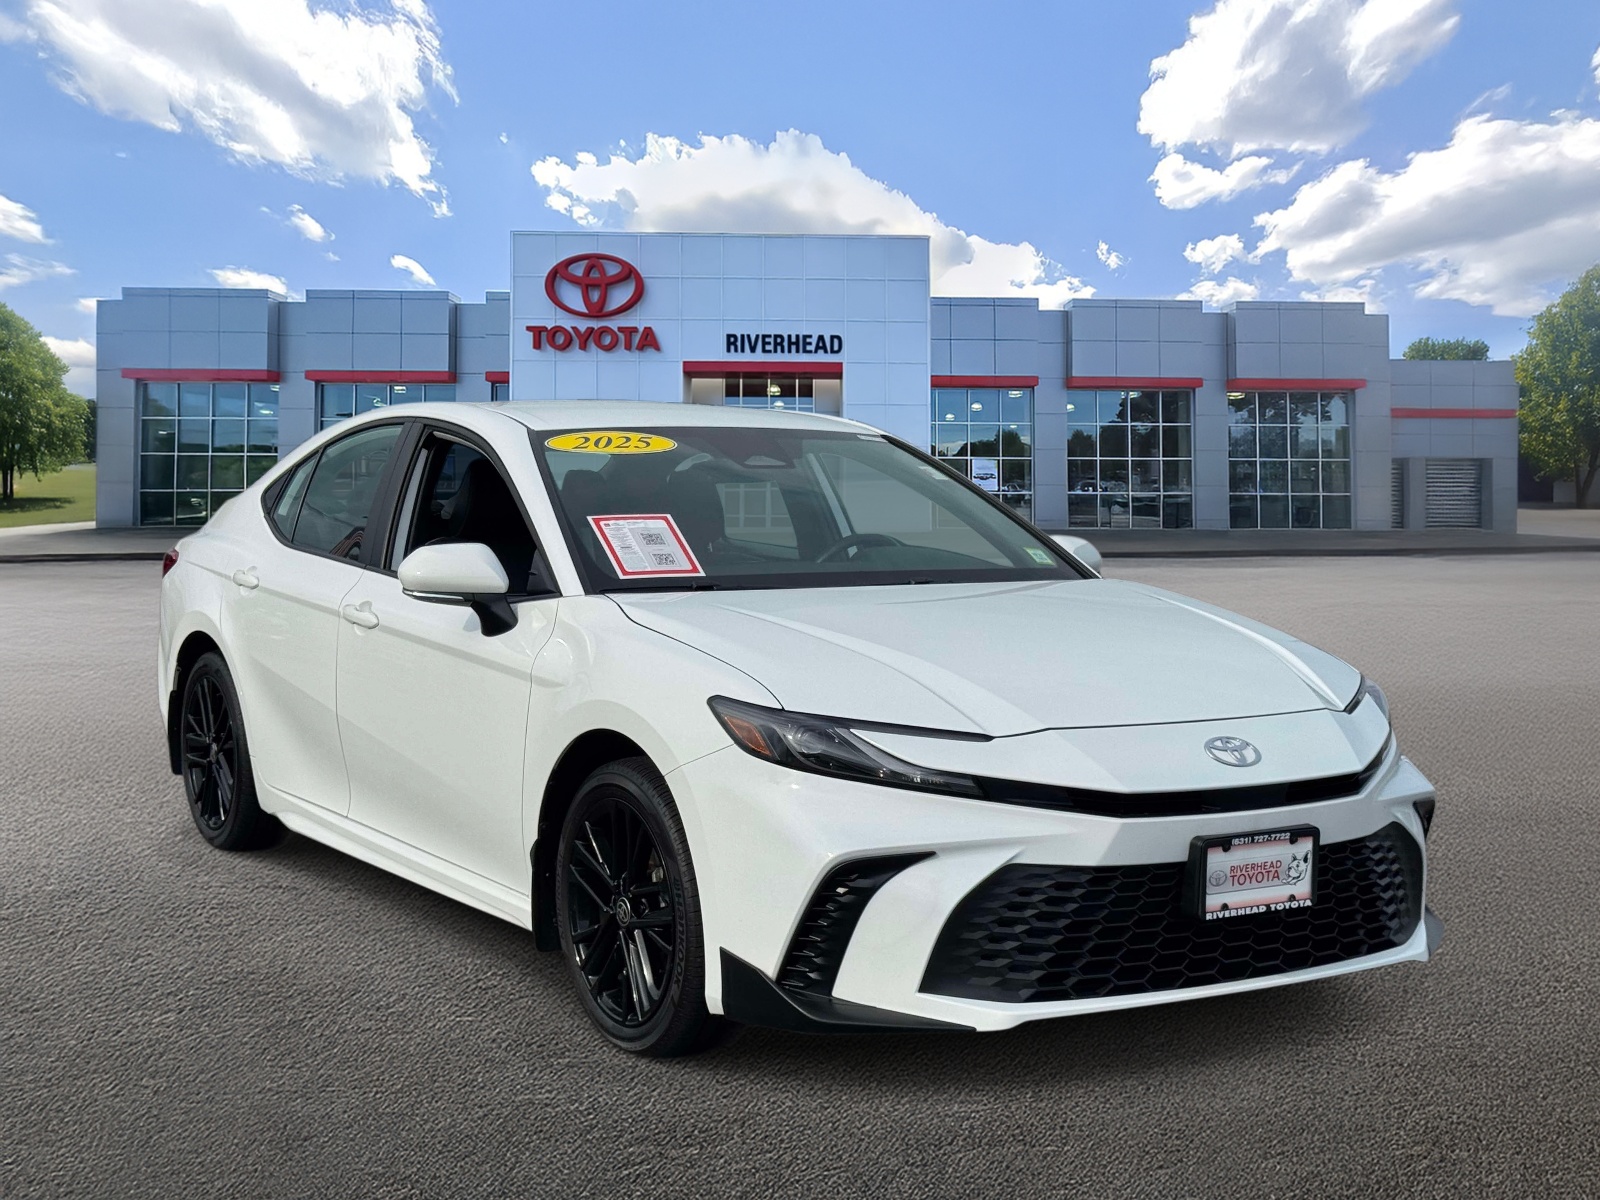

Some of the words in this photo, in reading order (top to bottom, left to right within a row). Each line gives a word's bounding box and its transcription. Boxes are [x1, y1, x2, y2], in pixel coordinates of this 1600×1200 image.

[526, 325, 661, 352] TOYOTA
[725, 333, 843, 354] RIVERHEAD
[572, 436, 653, 449] 2025
[1232, 837, 1252, 846] (631)
[1229, 860, 1282, 875] RIVERHEAD
[1229, 869, 1280, 887] TOYOTA
[1206, 905, 1267, 920] RIVERHEAD
[1270, 899, 1312, 912] TOYOTA
